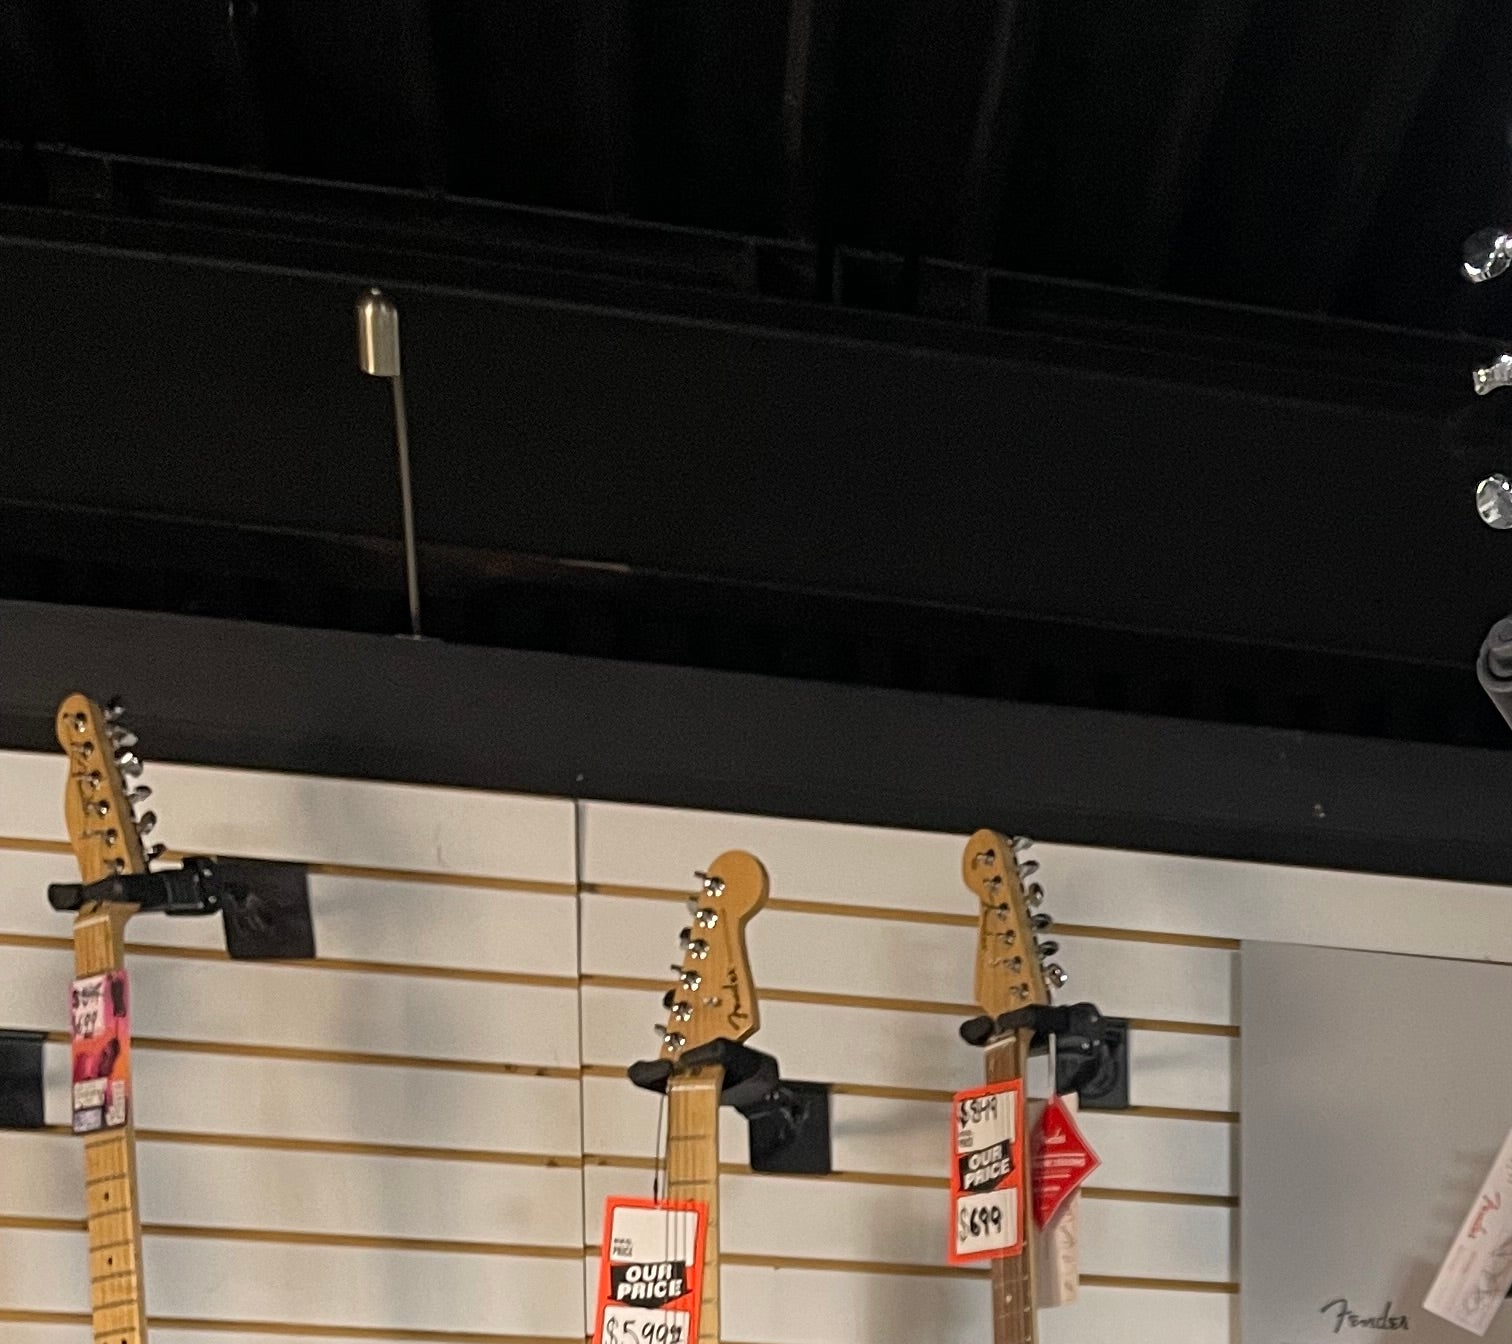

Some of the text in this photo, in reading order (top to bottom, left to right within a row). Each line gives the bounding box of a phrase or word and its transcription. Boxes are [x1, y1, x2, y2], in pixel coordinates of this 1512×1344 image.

[968, 1145, 1003, 1171] OUR
[964, 1158, 1010, 1190] PRICE
[625, 1263, 673, 1281] OUR
[616, 1280, 683, 1301] PRICE
[1320, 1298, 1409, 1334] Fender
